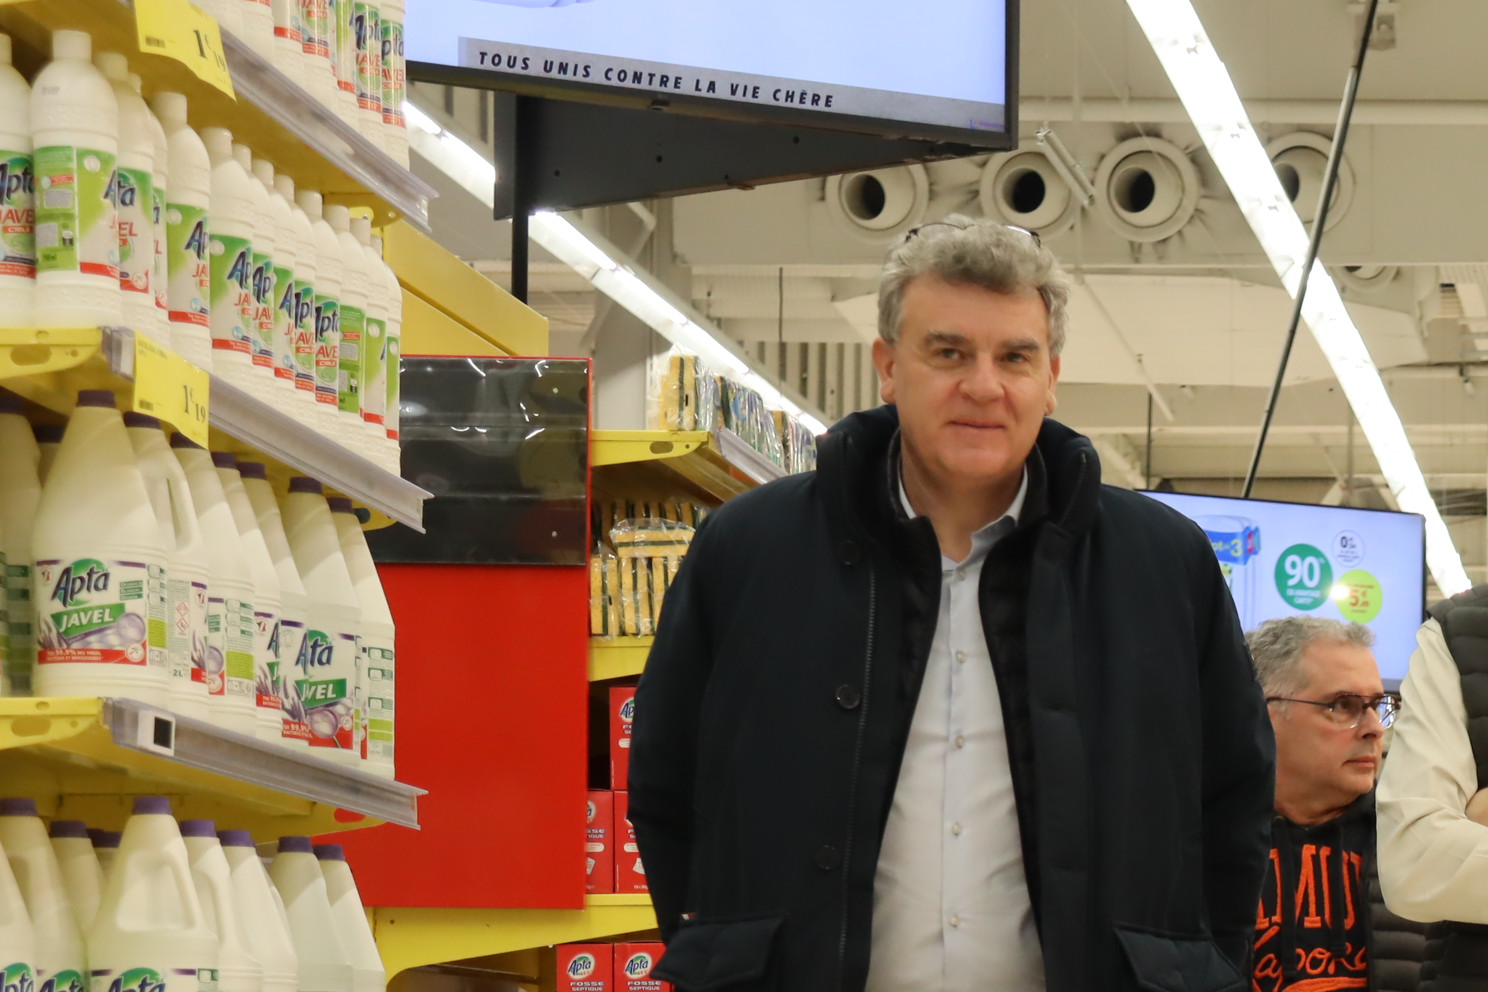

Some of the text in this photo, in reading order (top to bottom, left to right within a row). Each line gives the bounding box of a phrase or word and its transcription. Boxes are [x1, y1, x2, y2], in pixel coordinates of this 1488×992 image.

[479, 51, 834, 108] TOUS UNIS CONTRE LA VIE CHÈRE
[1284, 554, 1321, 588] 90
[52, 566, 111, 608] Apta
[60, 608, 114, 633] JAVEL
[568, 959, 591, 976] Apta
[625, 958, 648, 975] Apta
